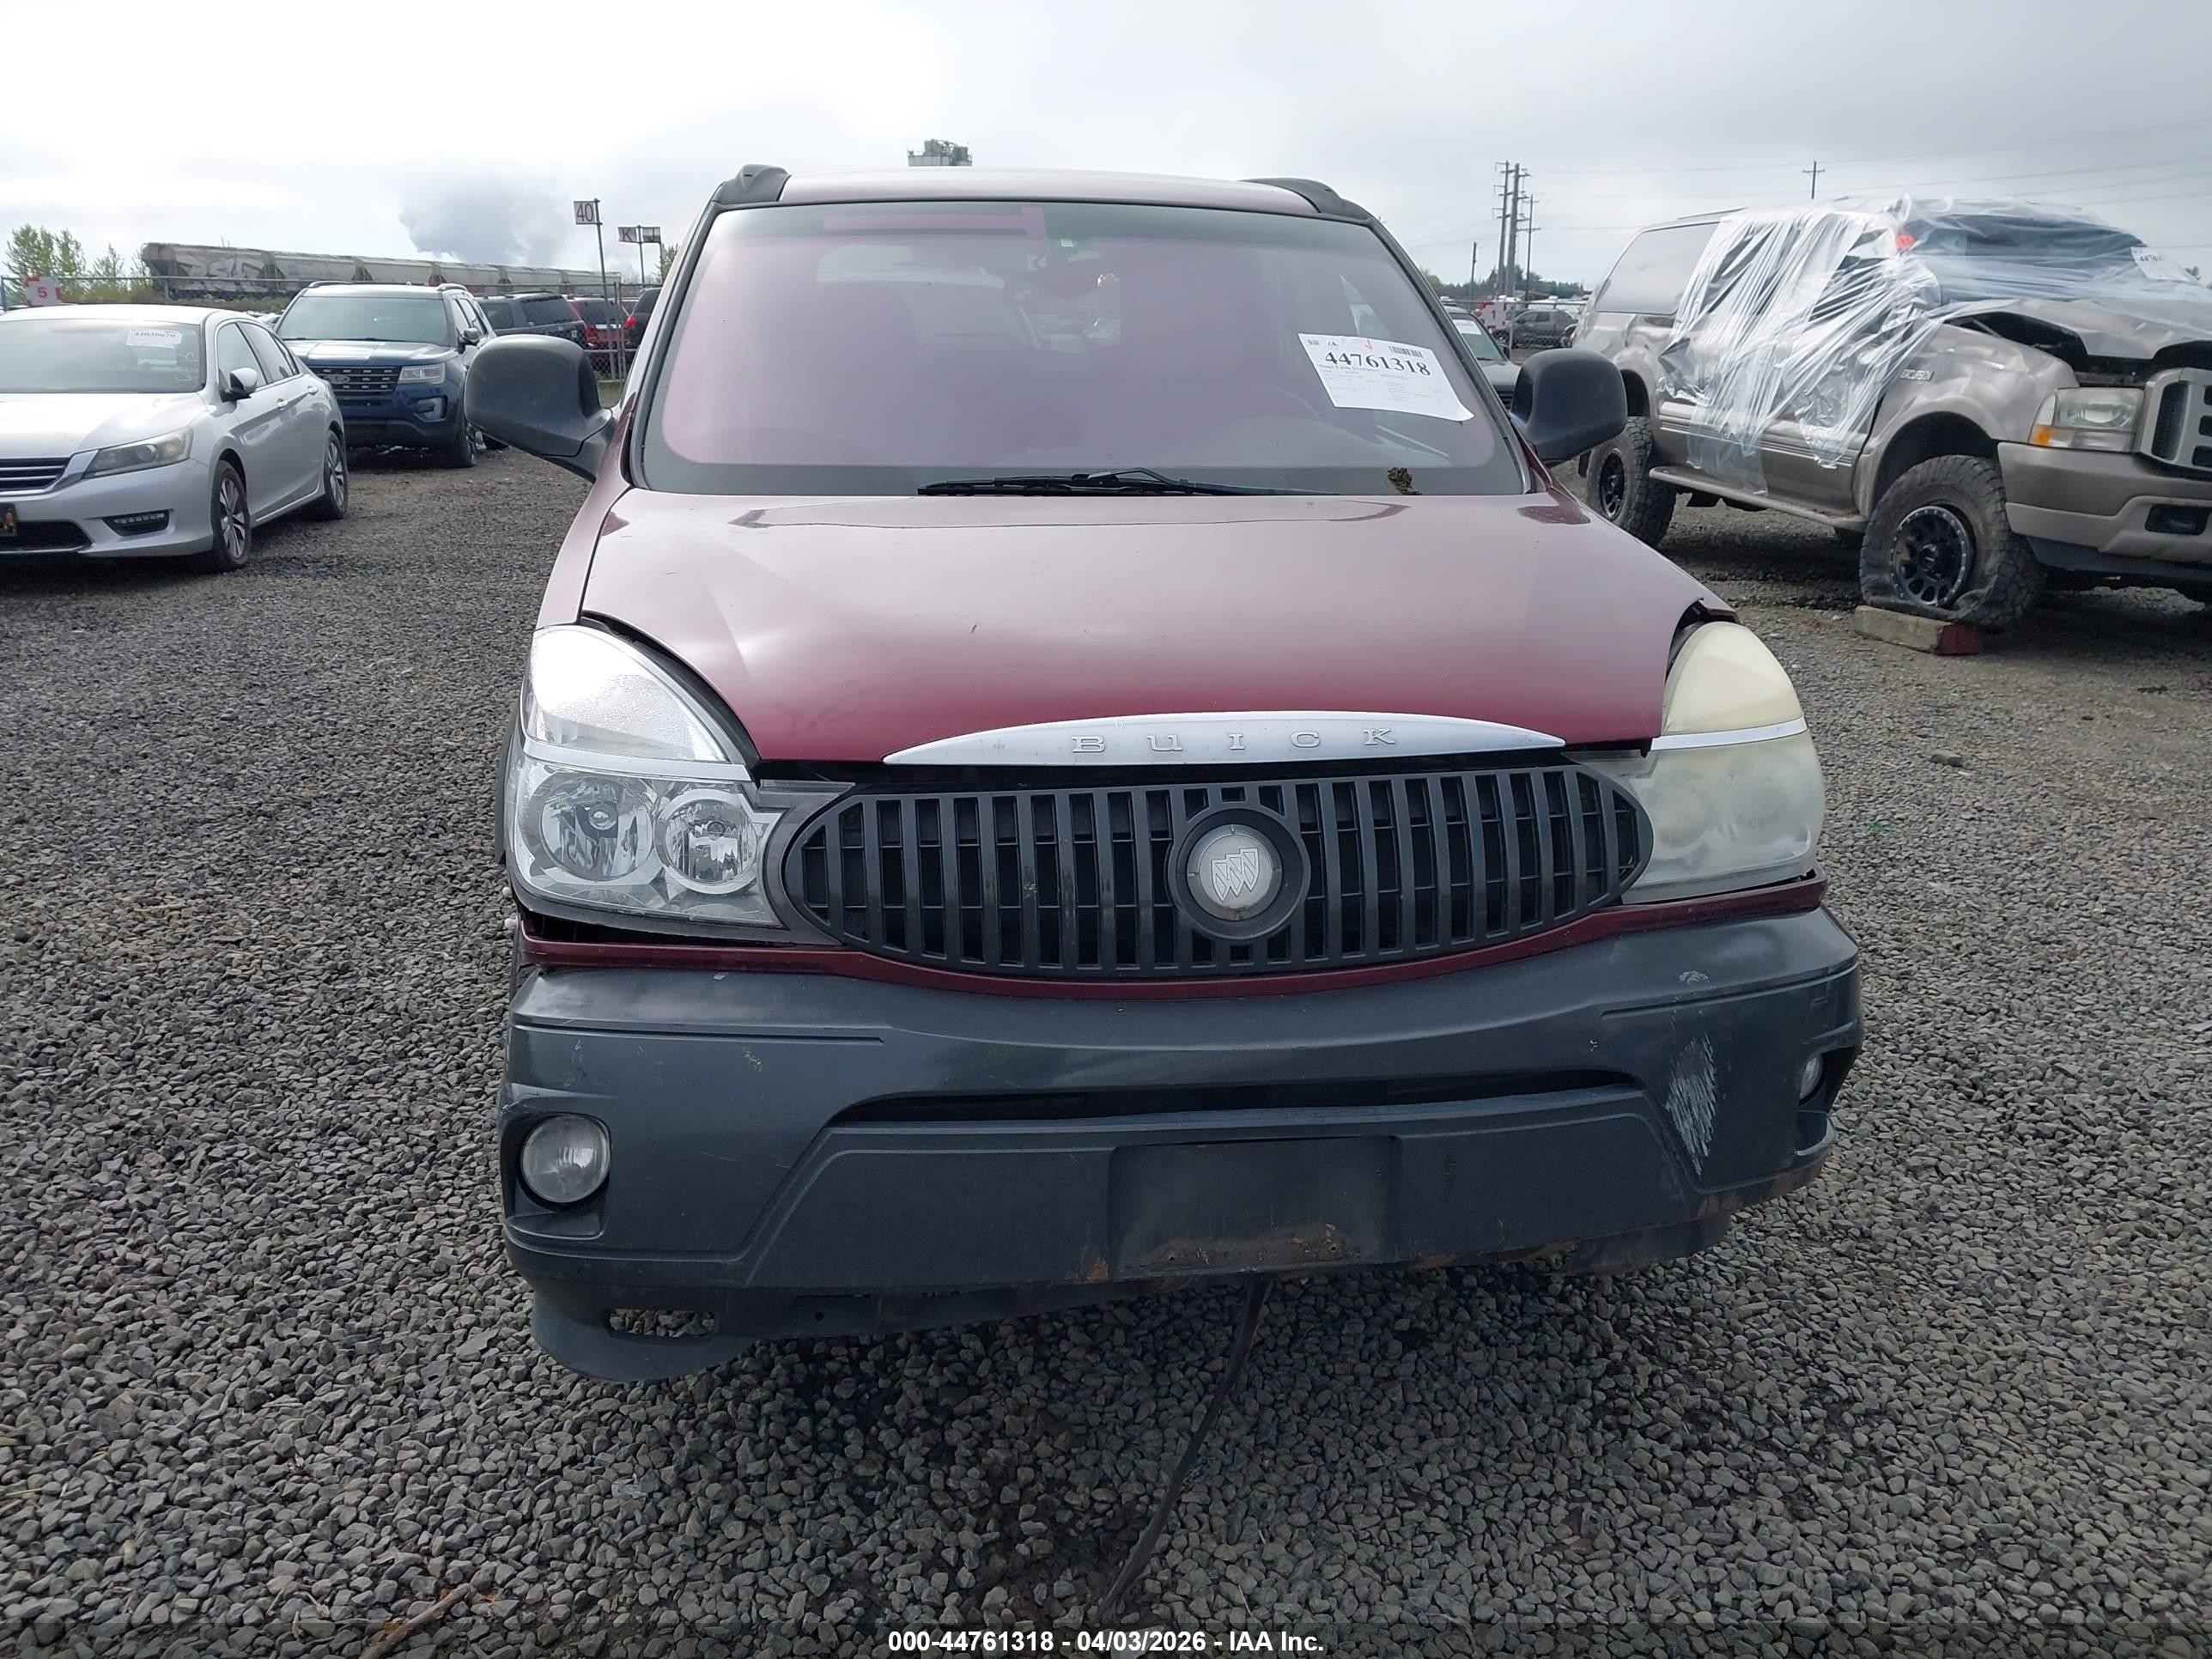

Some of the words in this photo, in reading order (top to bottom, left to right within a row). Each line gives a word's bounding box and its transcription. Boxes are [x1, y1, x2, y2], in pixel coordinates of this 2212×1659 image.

[576, 203, 594, 222] 40
[622, 228, 633, 242] K
[37, 287, 48, 299] 5
[1325, 351, 1431, 377] 44761318
[1071, 726, 1396, 754] BUICK
